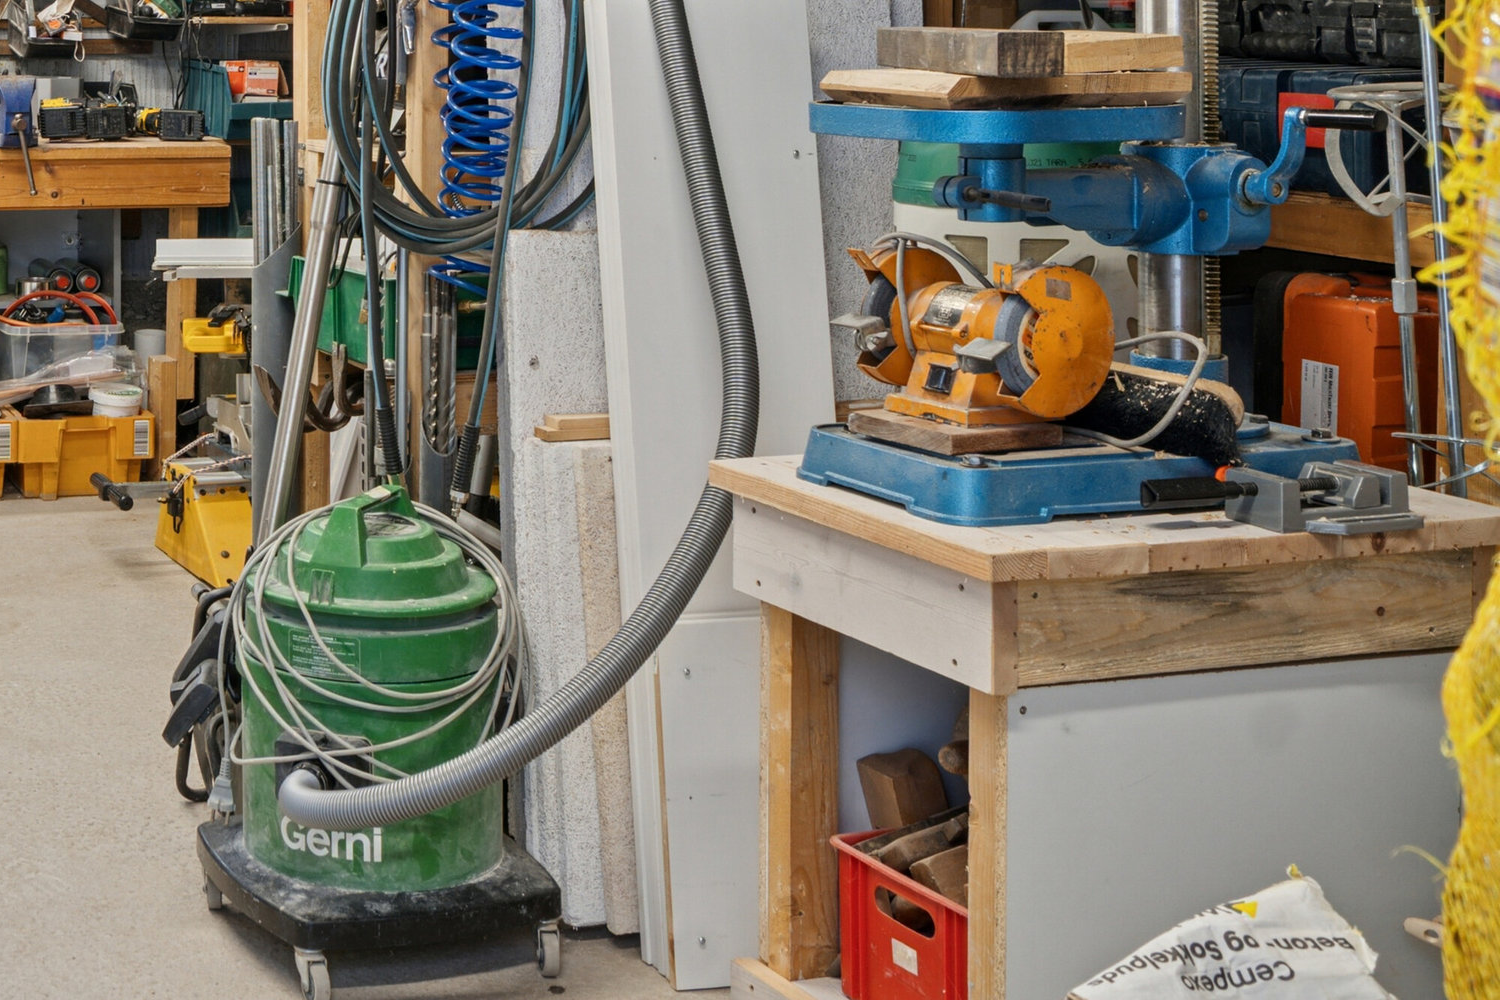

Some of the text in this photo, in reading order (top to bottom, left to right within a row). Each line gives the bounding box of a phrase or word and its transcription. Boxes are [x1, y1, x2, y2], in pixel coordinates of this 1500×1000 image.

[280, 815, 382, 862] Gerni
[1223, 930, 1260, 952] og
[1180, 960, 1296, 992] Cempexo
